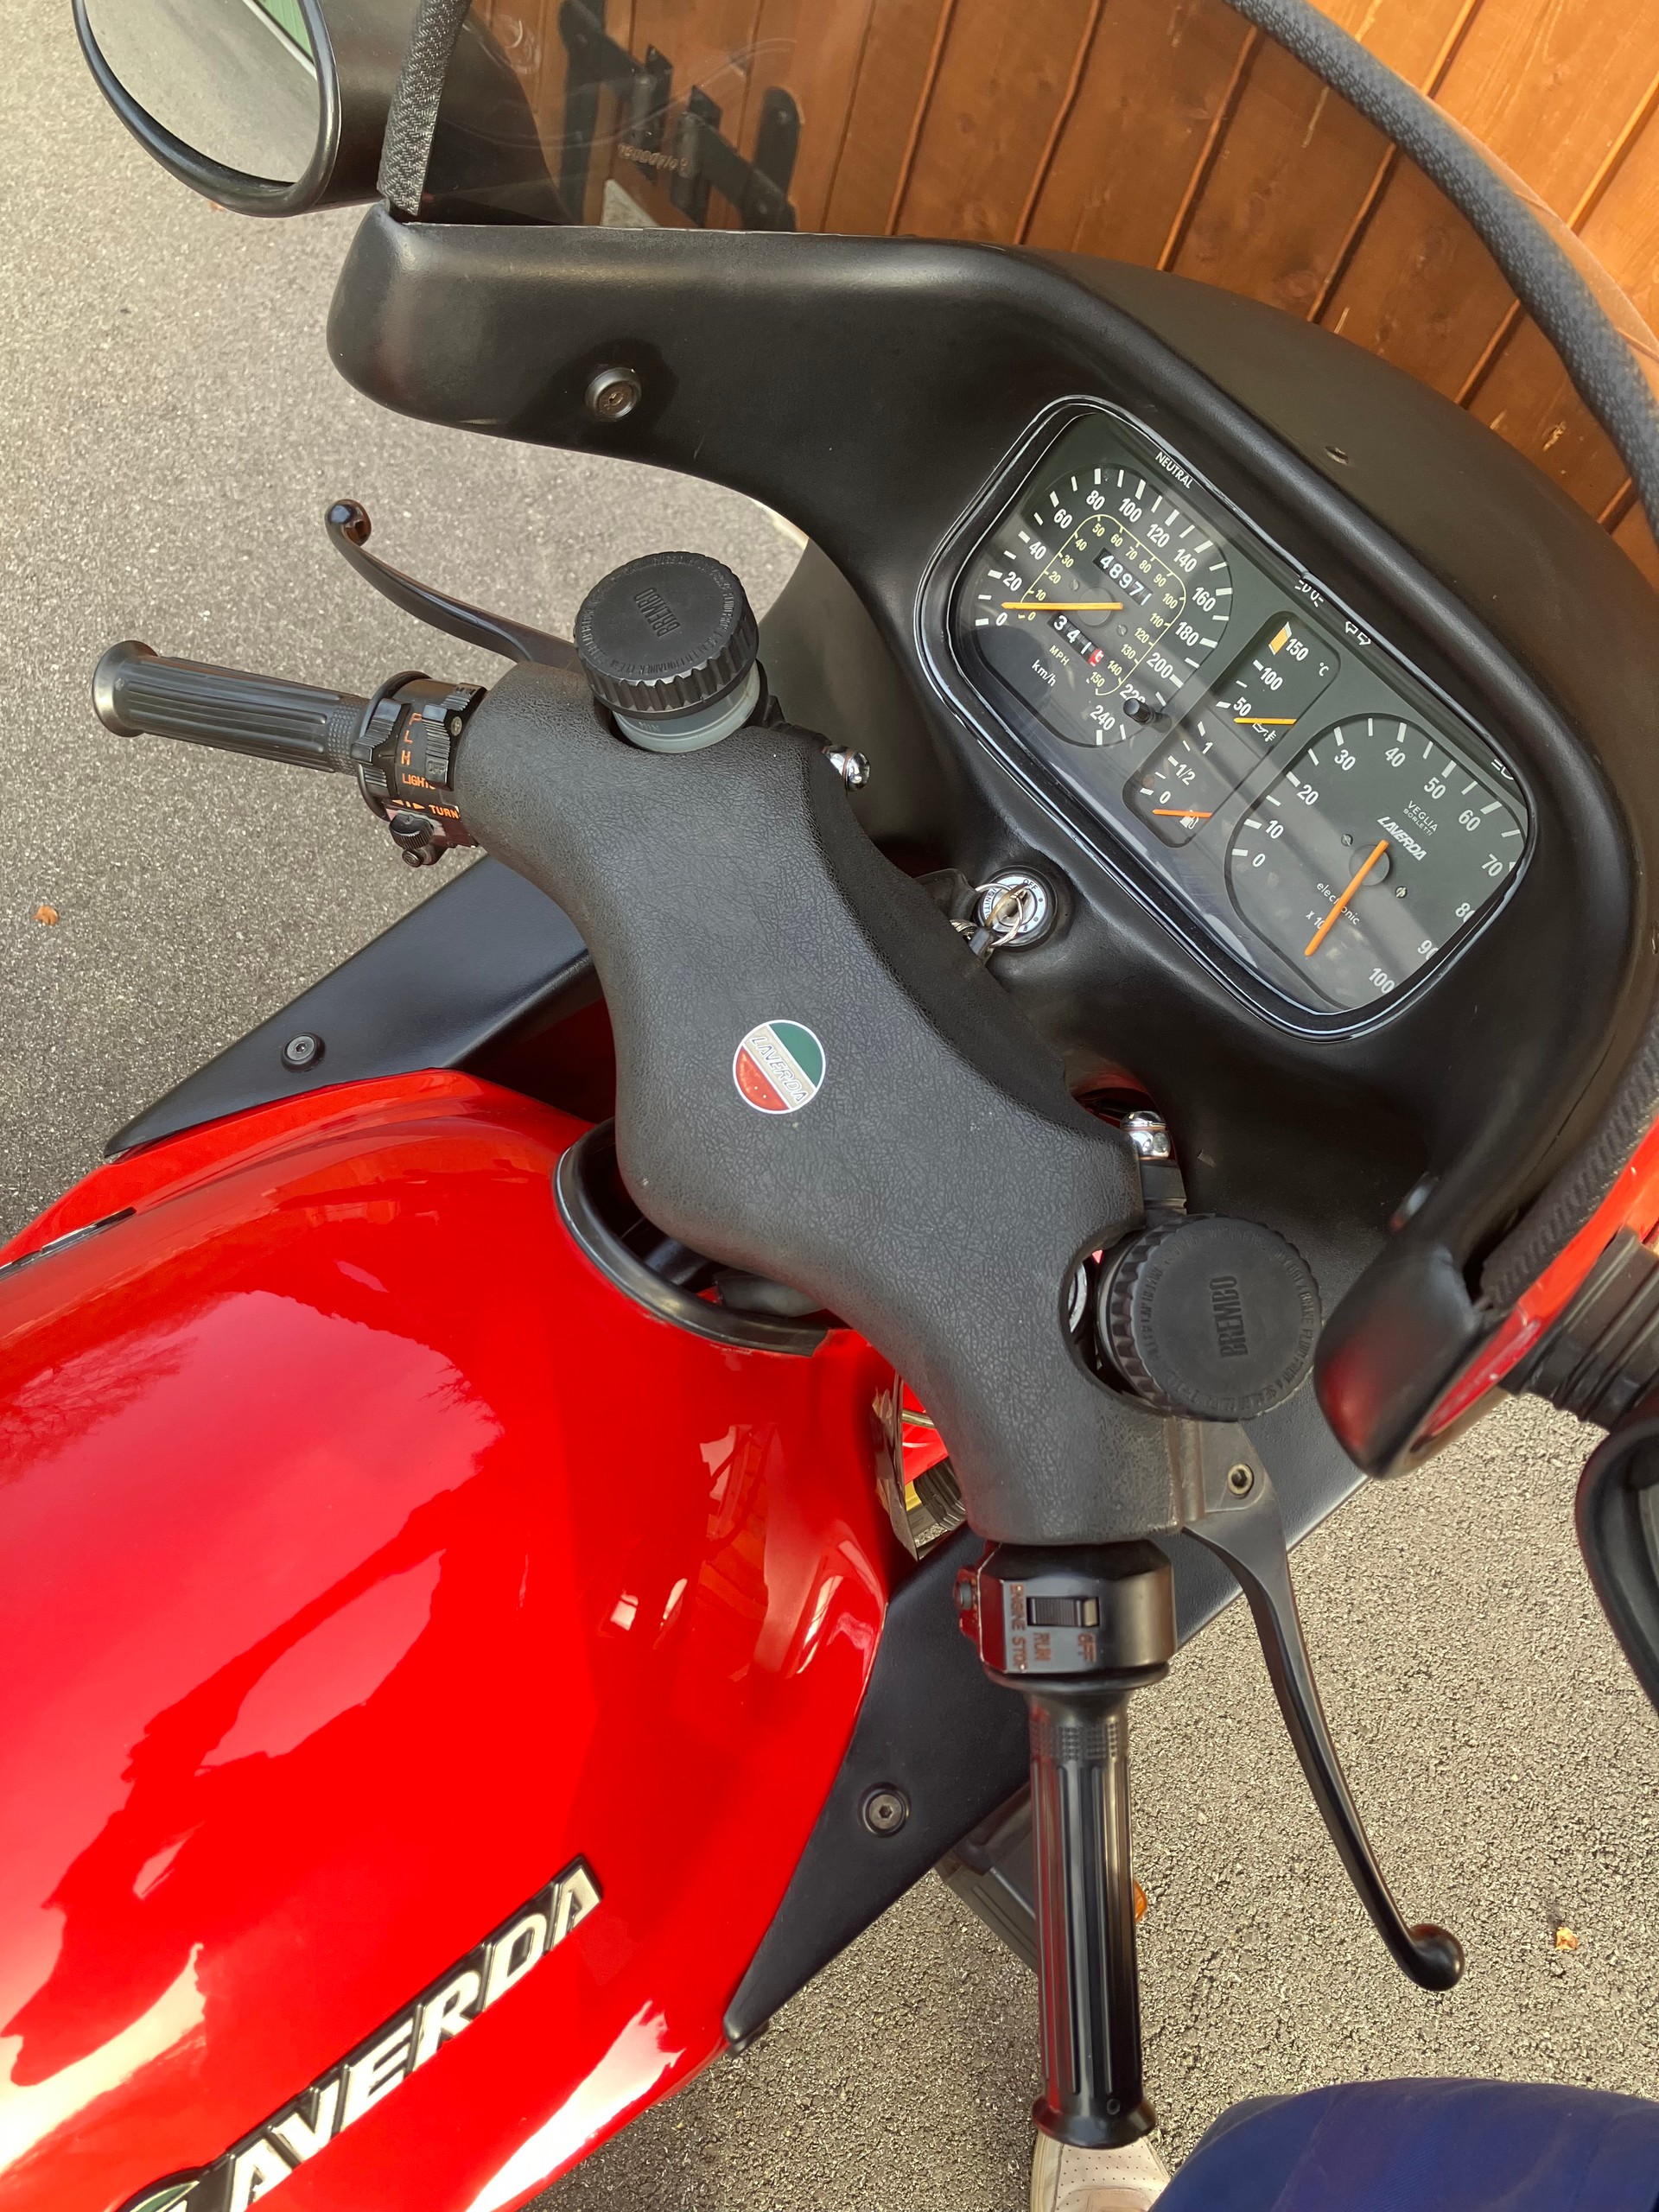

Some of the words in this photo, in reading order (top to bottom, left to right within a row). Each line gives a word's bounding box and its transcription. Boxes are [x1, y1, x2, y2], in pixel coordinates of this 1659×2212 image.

[1155, 452, 1193, 489] NEUTRAL
[1086, 490, 1105, 511] 80
[1119, 498, 1142, 523] 100
[1054, 508, 1073, 529] 60
[1092, 523, 1105, 537] 50
[1110, 533, 1123, 547] 60
[1147, 524, 1170, 548] 120
[1029, 541, 1046, 560] 40
[1075, 538, 1087, 551] 40
[1125, 546, 1138, 560] 70
[1061, 554, 1074, 568] 30
[1139, 559, 1152, 574] 80
[1173, 548, 1198, 573] 140
[1003, 571, 1022, 591] 20
[1048, 570, 1061, 584] 20
[1100, 555, 1152, 606] 48971
[1153, 573, 1166, 588] 90
[1035, 588, 1046, 601] 10
[1162, 593, 1178, 609] 100
[1192, 587, 1216, 612] 160
[633, 587, 681, 638] BREMBO
[995, 612, 1007, 626] 0
[1027, 612, 1036, 621] 0
[1149, 613, 1164, 628] 110
[1134, 627, 1150, 644] 120
[1175, 621, 1199, 646] 180
[1049, 645, 1070, 666] MPH
[1121, 644, 1136, 659] 130
[1285, 639, 1309, 661] 150
[1031, 659, 1056, 687] km/h
[1107, 660, 1122, 677] 140
[1147, 652, 1173, 679] 200
[1090, 671, 1105, 688] 150
[1260, 667, 1283, 690] 100
[1233, 696, 1252, 716] 50
[1090, 704, 1116, 731] 240
[404, 730, 413, 744] L
[1202, 741, 1214, 754] 1
[401, 750, 410, 766] H
[1334, 749, 1357, 771] 30
[1384, 747, 1406, 767] 40
[1176, 764, 1195, 785] 1/2
[1159, 791, 1172, 804] 0
[1296, 784, 1319, 805] 20
[1423, 777, 1446, 799] 50
[1402, 808, 1433, 836] BORLETTI
[1408, 800, 1439, 832] VEGLIA
[1459, 809, 1481, 832] 60
[1265, 820, 1284, 839] 10
[1376, 816, 1427, 861] LAVERDA
[1252, 853, 1266, 868] 0
[1481, 853, 1503, 877] 70
[1023, 879, 1038, 890] OFF
[1317, 882, 1360, 925] electonic
[1368, 967, 1395, 995] 100
[750, 1037, 808, 1102] LAVERDA
[1211, 1275, 1249, 1358] BREMBO
[1010, 1584, 1026, 1631] ENGINE
[1033, 1632, 1051, 1662] RUN
[168, 1865, 602, 2212] AVERDA
